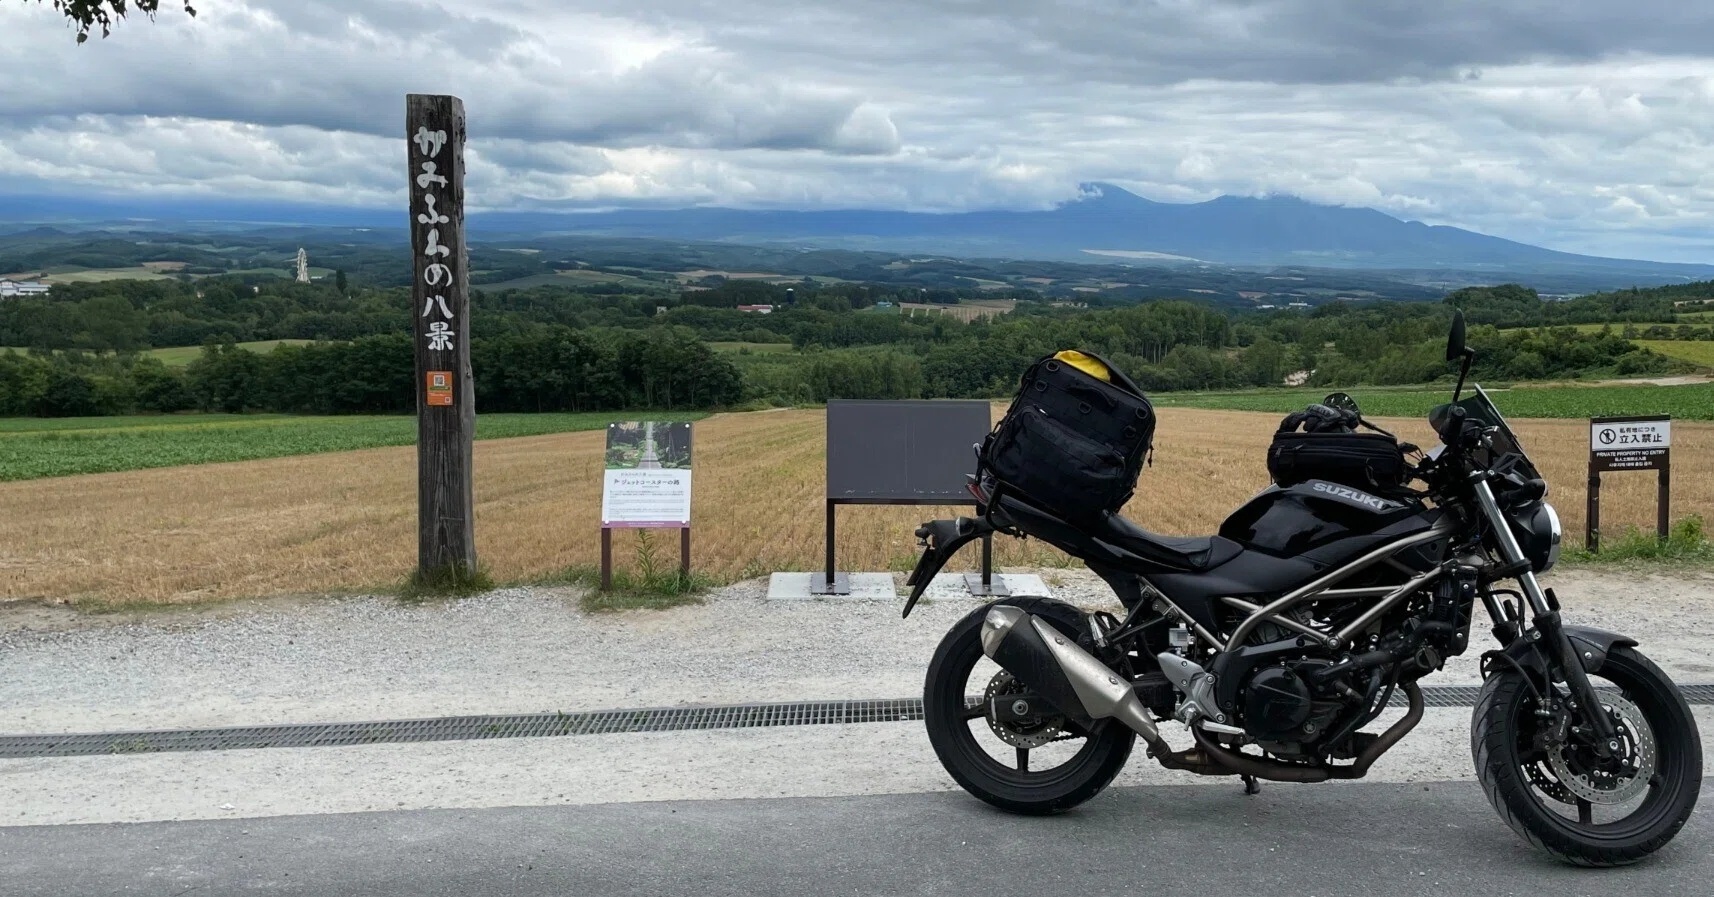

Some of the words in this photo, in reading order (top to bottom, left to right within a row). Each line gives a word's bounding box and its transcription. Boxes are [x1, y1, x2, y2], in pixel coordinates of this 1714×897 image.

[413, 126, 455, 351] かみふらの八景
[1620, 433, 1662, 444] 立入禁止
[1313, 483, 1384, 509] SUZUKI
